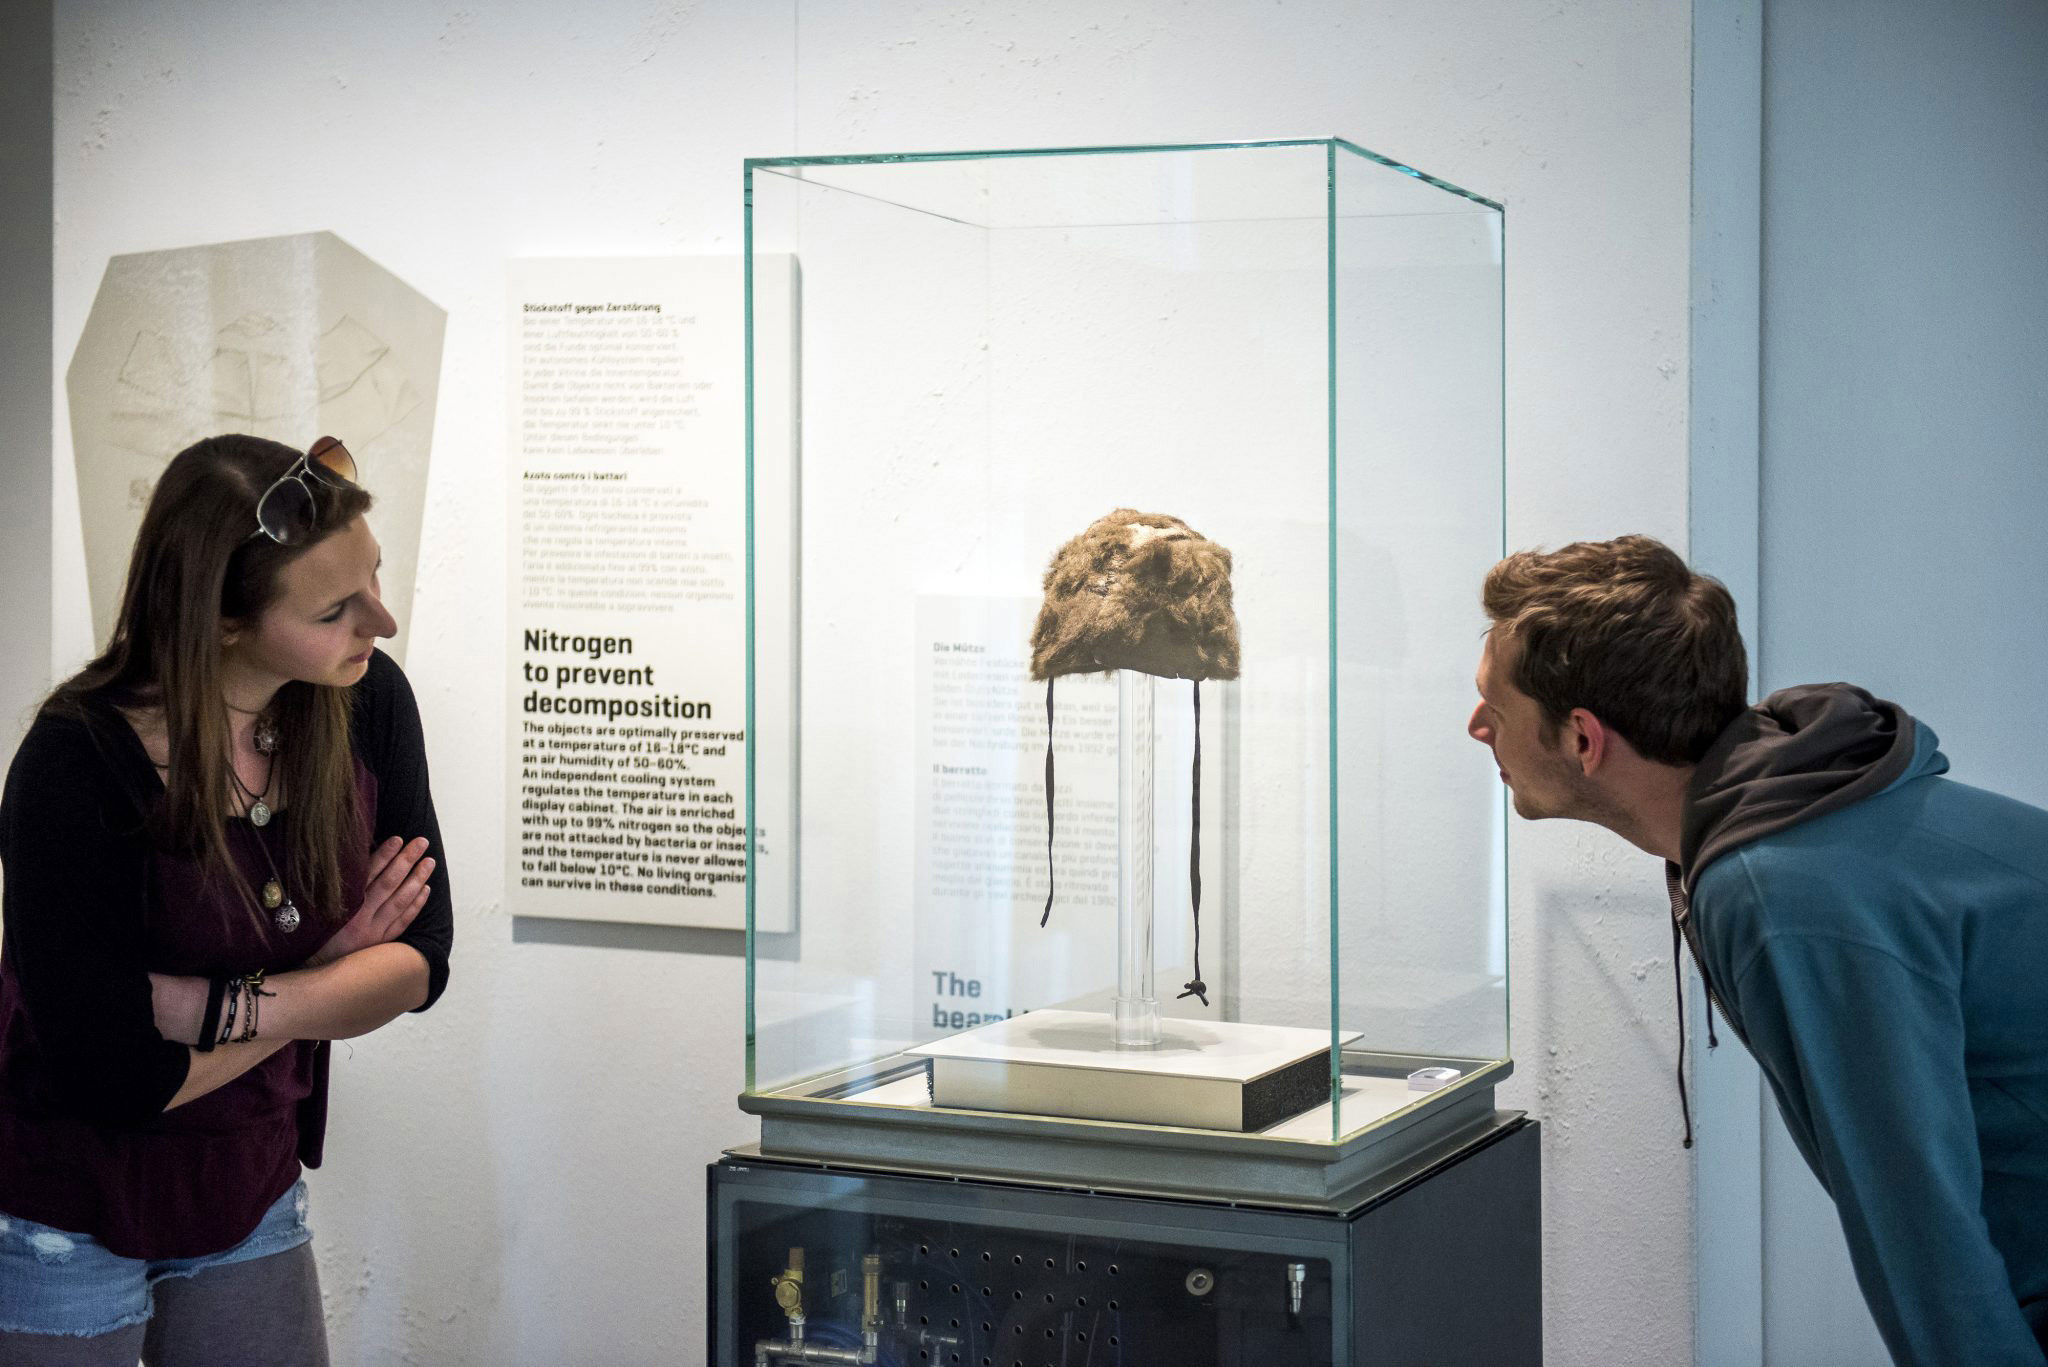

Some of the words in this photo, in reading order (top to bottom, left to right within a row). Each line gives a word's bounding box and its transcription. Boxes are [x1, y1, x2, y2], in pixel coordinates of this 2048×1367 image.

[523, 304, 573, 312] Stickstoff
[574, 306, 604, 314] gegen
[588, 472, 591, 480] i
[524, 629, 632, 659] Nitrogen
[933, 642, 950, 652] Die
[953, 642, 985, 653] Mütze
[523, 662, 548, 682] to
[556, 665, 654, 689] prevent
[523, 690, 711, 722] decomposition
[523, 721, 544, 733] The
[547, 723, 592, 737] objects
[596, 727, 616, 736] are
[619, 726, 677, 740] optimally
[681, 728, 744, 743] preserved
[523, 739, 535, 748] at
[538, 740, 545, 748] a
[548, 740, 626, 754] temperature
[629, 741, 642, 752] of
[703, 745, 726, 756] and
[522, 755, 537, 764] an
[540, 755, 556, 764] air
[559, 754, 614, 769] humidity
[617, 756, 630, 768] of
[522, 768, 538, 779] An
[541, 768, 617, 785] independent
[621, 772, 666, 787] cooling
[670, 775, 715, 789] system
[522, 783, 580, 799] regulates
[584, 786, 603, 797] the
[606, 788, 685, 803] temperature
[688, 792, 700, 802] in
[703, 792, 733, 804] each
[522, 798, 565, 813] display
[622, 803, 644, 815] The
[647, 806, 663, 816] air
[666, 806, 677, 816] is
[680, 806, 735, 820] enriched
[522, 813, 549, 826] with
[552, 818, 567, 829] up
[571, 817, 583, 828] to
[587, 816, 615, 830] 99%
[619, 820, 672, 834] nitrogen
[675, 824, 689, 833] so
[693, 822, 713, 834] the
[522, 832, 542, 841] are
[545, 831, 565, 842] not
[568, 832, 623, 845] attacked
[626, 834, 641, 848] by
[644, 835, 697, 849] bacteria
[700, 840, 713, 850] or
[522, 844, 544, 856] and
[548, 846, 568, 858] the
[570, 848, 649, 864] temperature
[652, 852, 662, 863] is
[665, 854, 700, 865] never
[704, 854, 745, 868] allowe
[522, 860, 534, 872] to
[538, 860, 557, 872] fall
[560, 862, 596, 875] below
[637, 866, 654, 878] No
[657, 867, 691, 882] living
[522, 877, 543, 887] can
[547, 876, 591, 890] survive
[595, 879, 606, 891] in
[609, 880, 643, 893] these
[647, 882, 715, 898] conditions.
[932, 971, 981, 998] The
